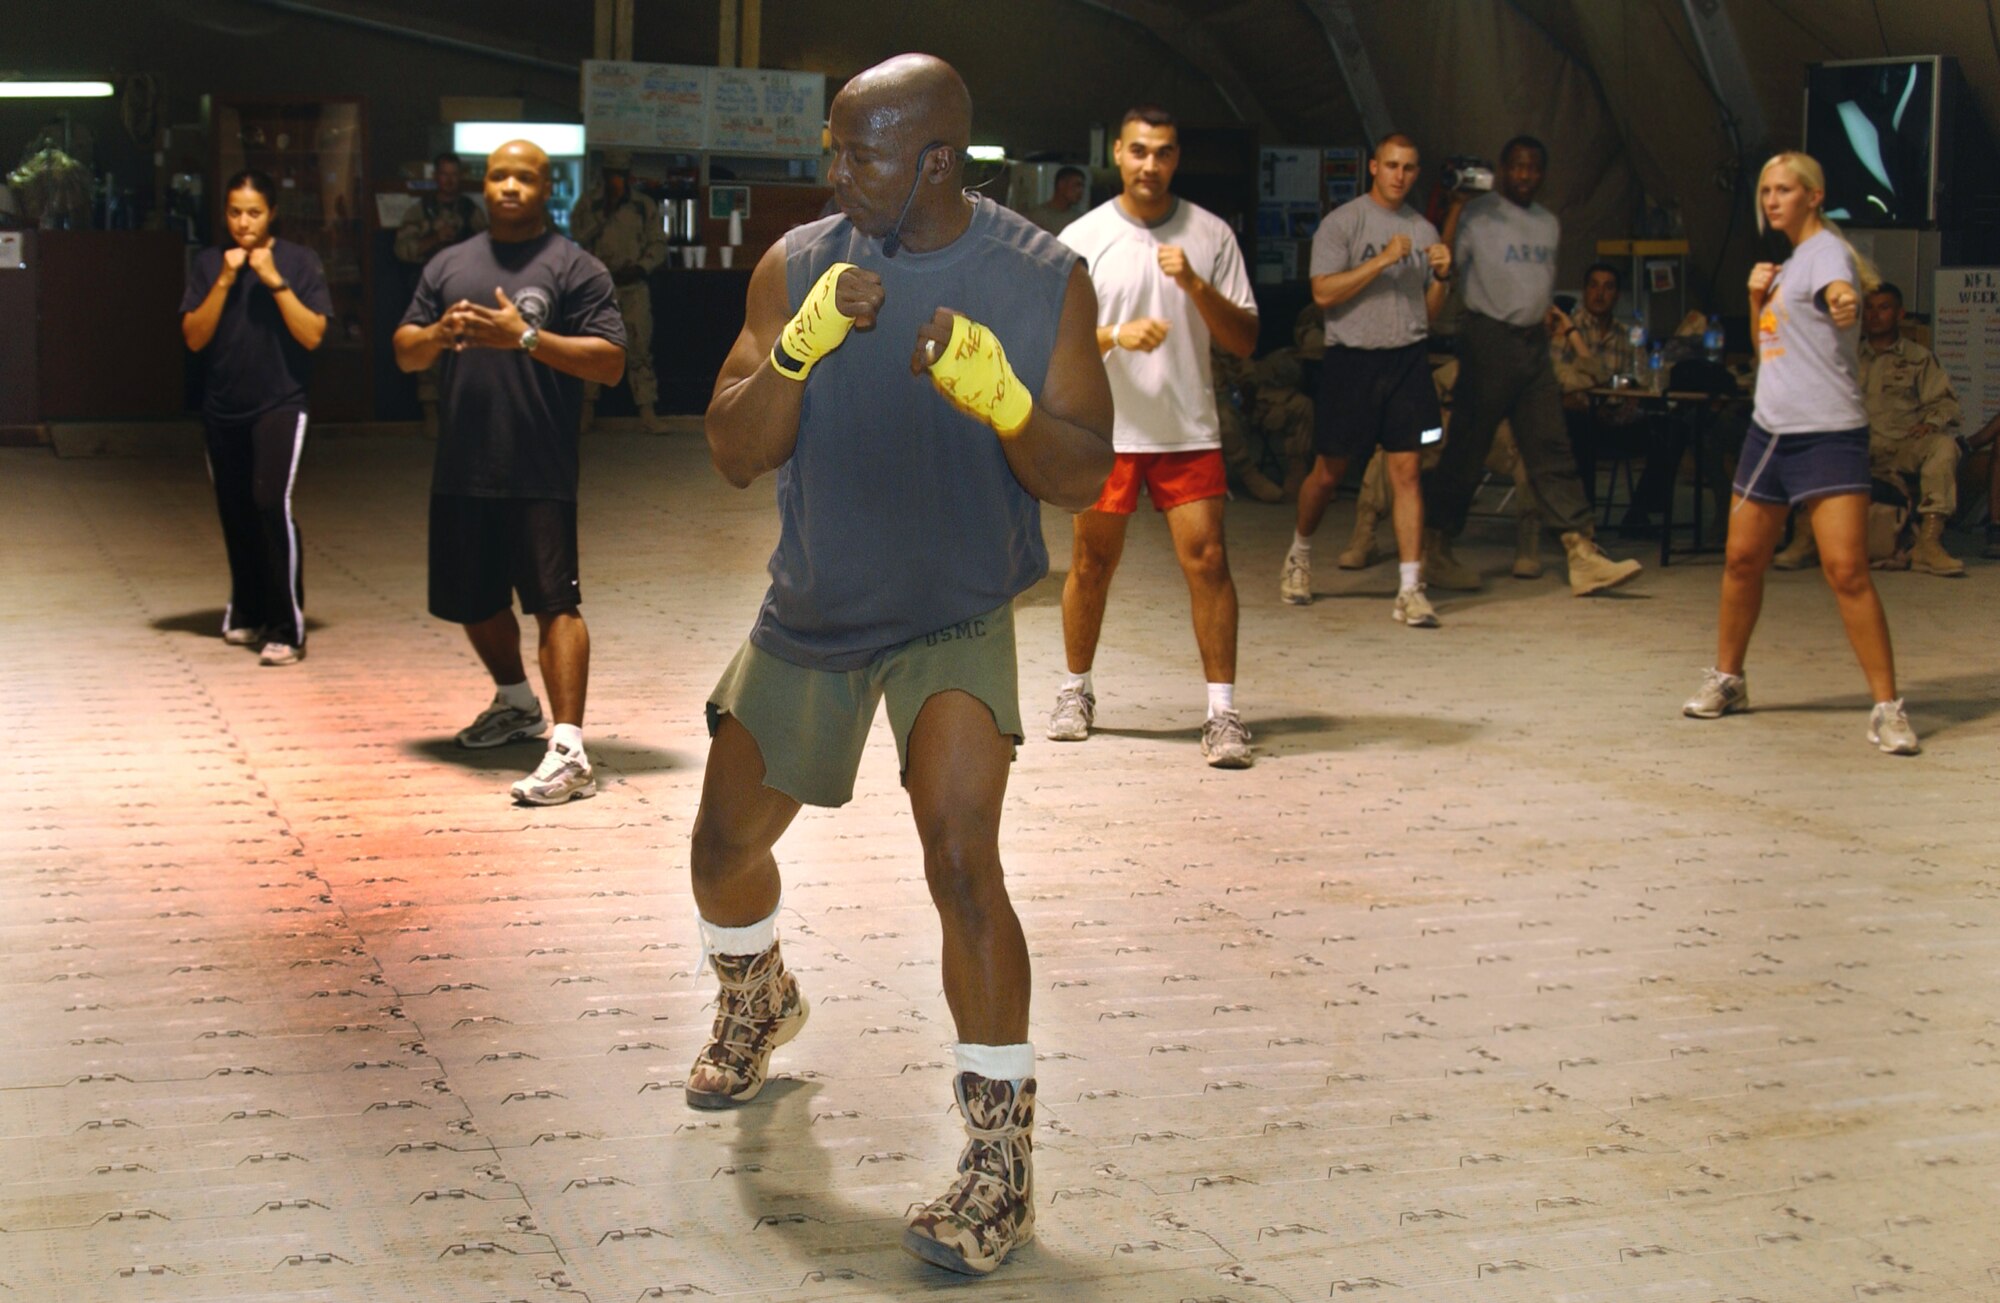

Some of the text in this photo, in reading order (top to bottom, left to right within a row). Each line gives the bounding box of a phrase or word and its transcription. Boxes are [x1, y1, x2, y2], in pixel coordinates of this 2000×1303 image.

[1964, 272, 1996, 288] NFL
[1959, 290, 1999, 304] WEEK
[926, 619, 987, 647] USMC
